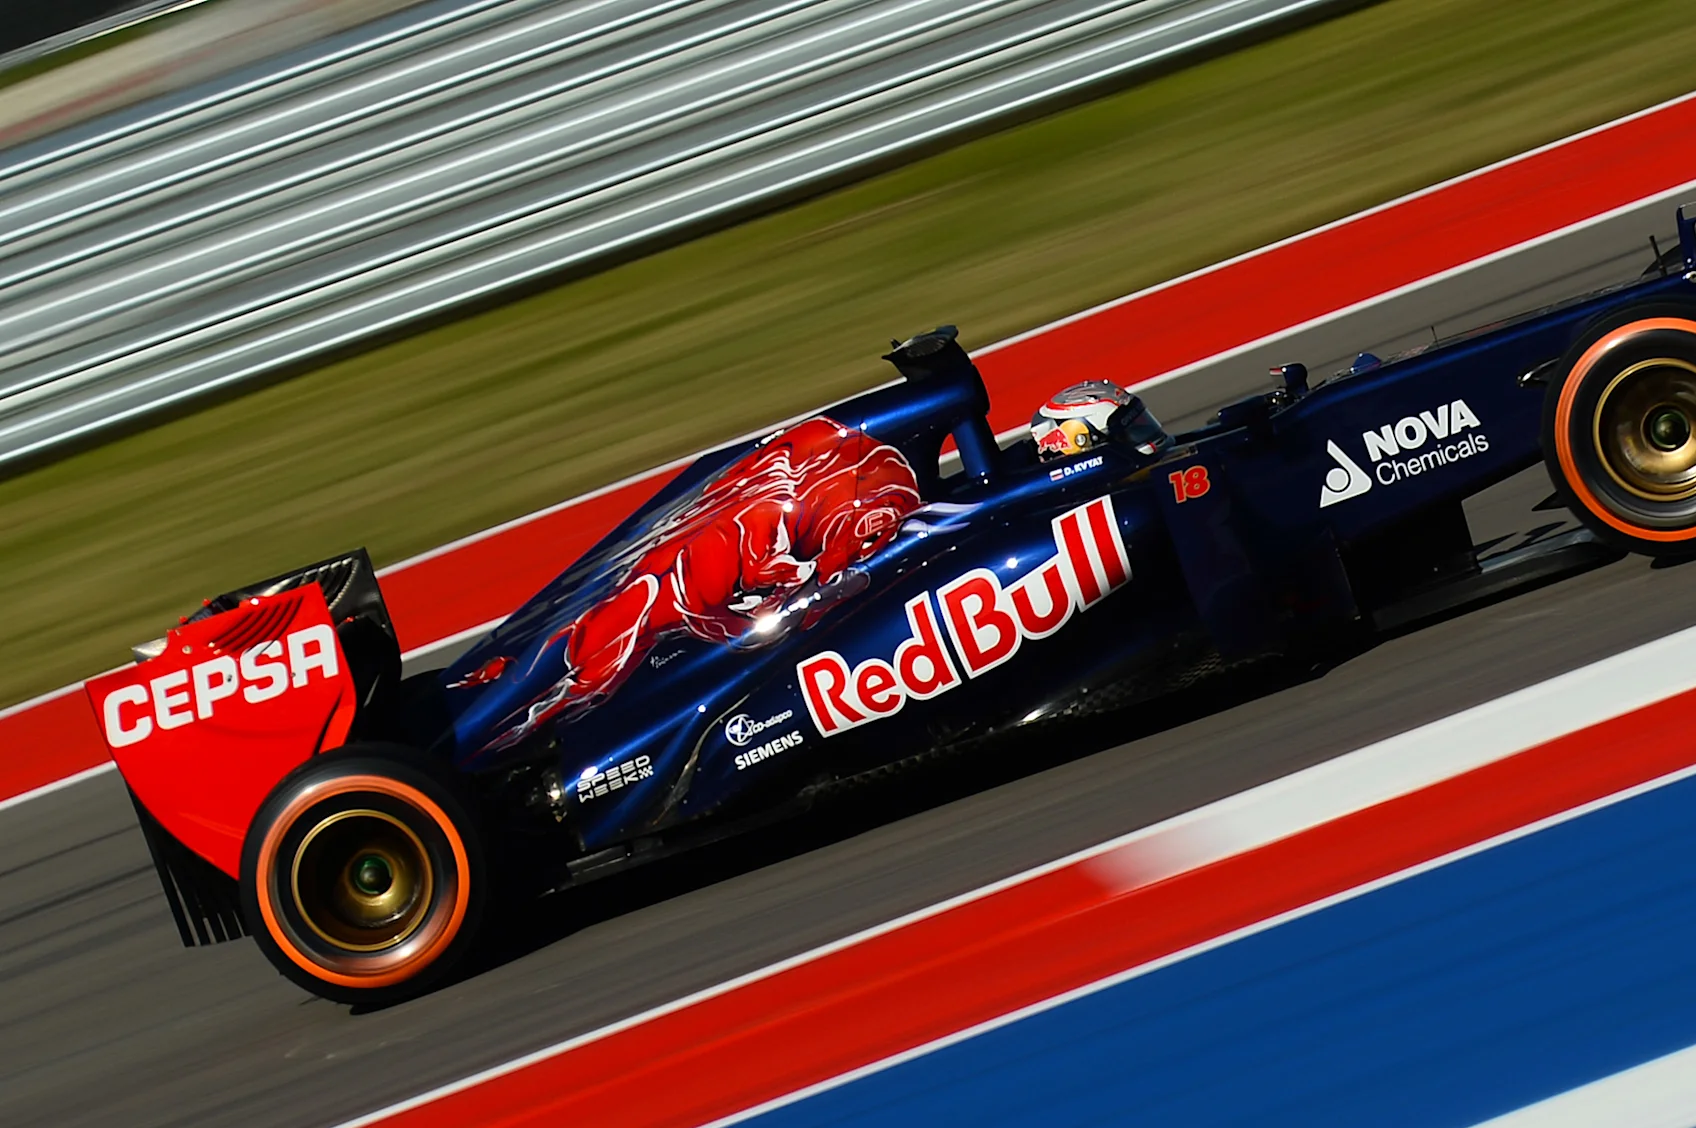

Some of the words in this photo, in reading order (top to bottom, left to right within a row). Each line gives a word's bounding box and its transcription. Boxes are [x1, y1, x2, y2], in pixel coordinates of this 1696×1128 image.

[1362, 399, 1481, 462] NOVA
[1375, 433, 1490, 485] Chemicals
[1169, 465, 1210, 503] 18
[798, 592, 960, 737] Red
[938, 496, 1131, 677] Bull
[103, 623, 339, 748] CEPSA
[734, 730, 804, 770] SIEMENS
[576, 755, 651, 792] SPEED
[578, 771, 640, 803] WEEK
